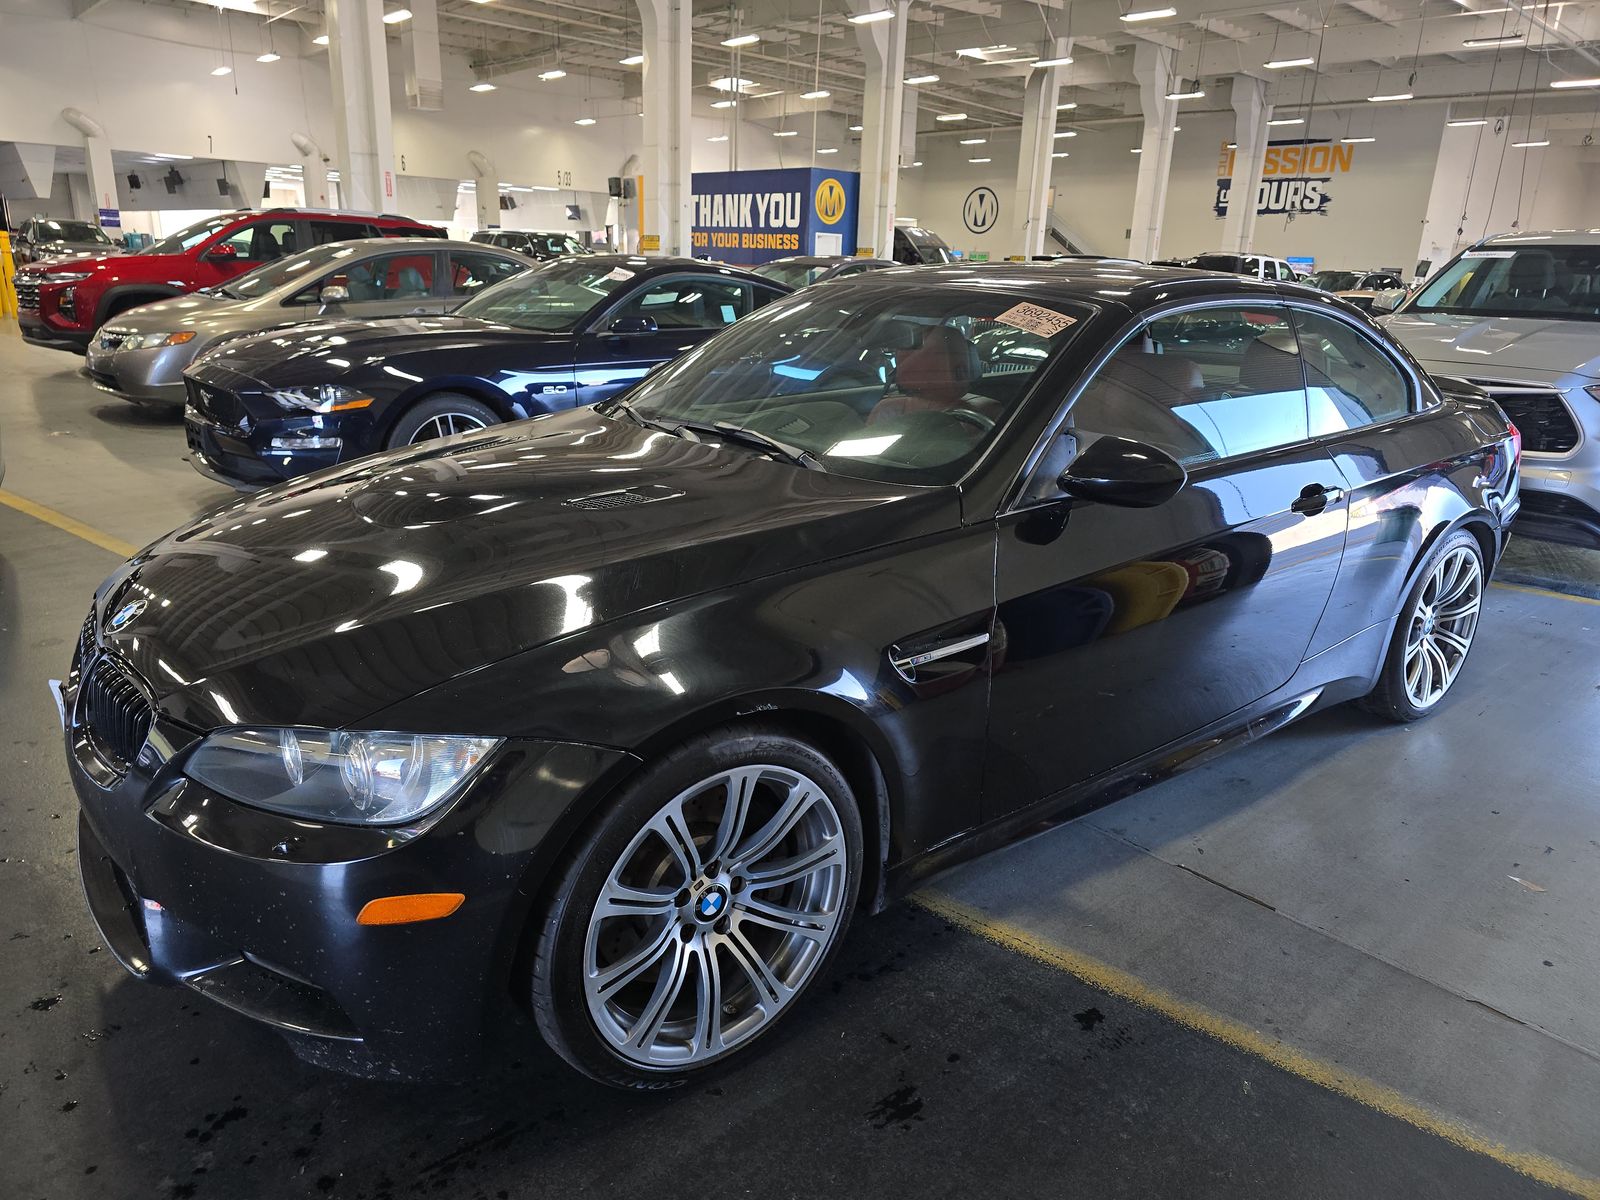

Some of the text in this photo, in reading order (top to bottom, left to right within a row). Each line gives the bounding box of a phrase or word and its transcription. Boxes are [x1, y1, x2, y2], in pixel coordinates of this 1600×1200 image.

[691, 192, 801, 228] THANK YOU
[1256, 180, 1323, 210] OURS
[711, 232, 739, 248] YOUR
[742, 233, 799, 250] BUSINESS
